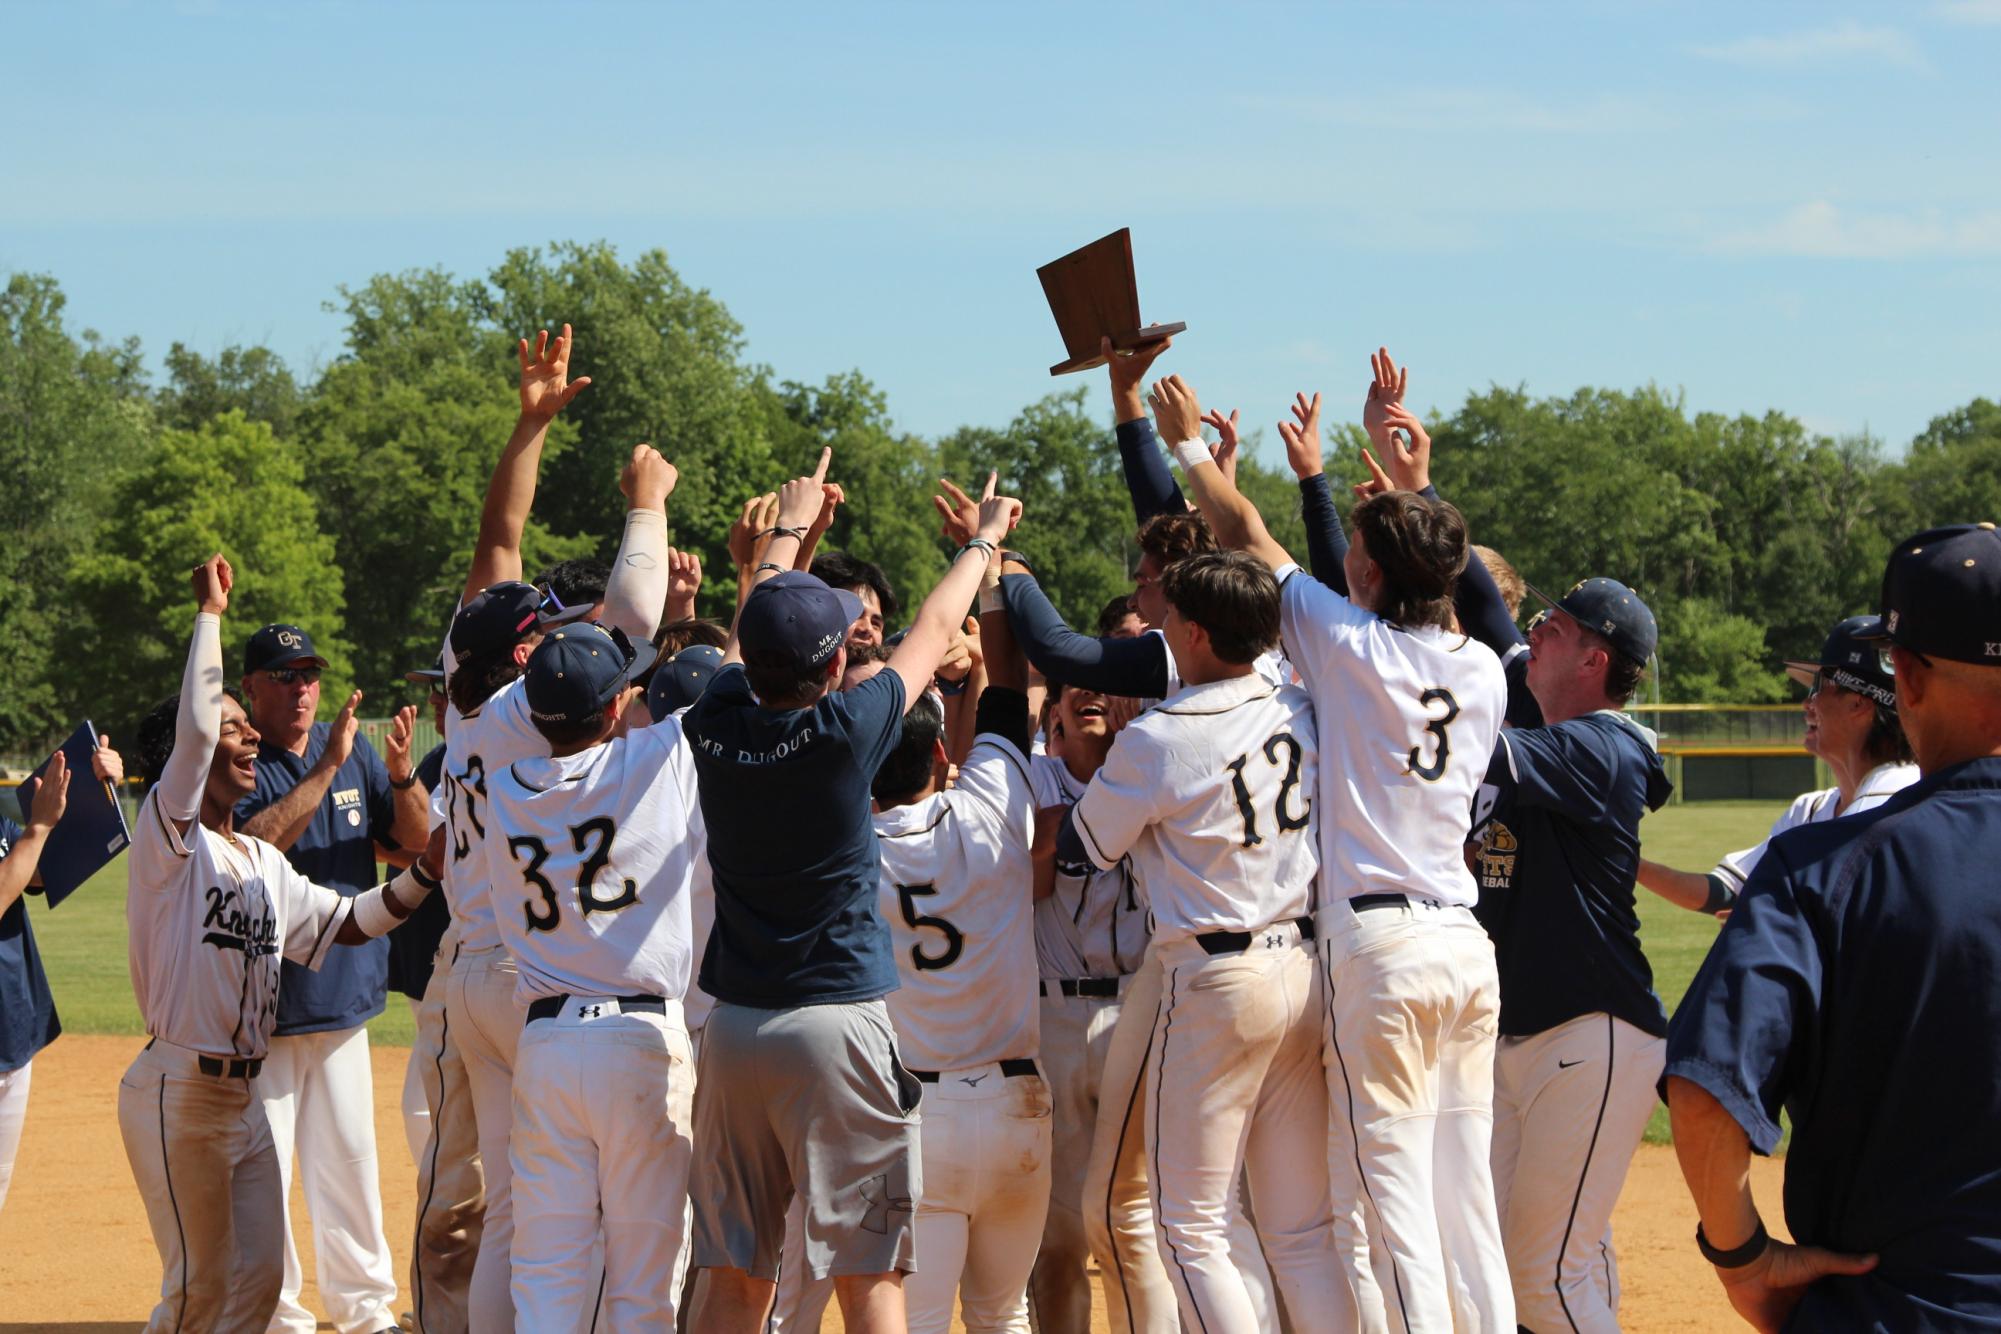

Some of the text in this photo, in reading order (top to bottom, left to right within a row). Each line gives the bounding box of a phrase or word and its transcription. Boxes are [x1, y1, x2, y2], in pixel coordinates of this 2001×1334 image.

[812, 631, 842, 663] DUGOUT
[819, 634, 833, 648] MR.
[698, 728, 812, 765] MR DUGOUT
[1404, 686, 1461, 783] 3
[1224, 732, 1312, 848] 12
[506, 815, 642, 934] 32
[894, 881, 965, 972] 5
